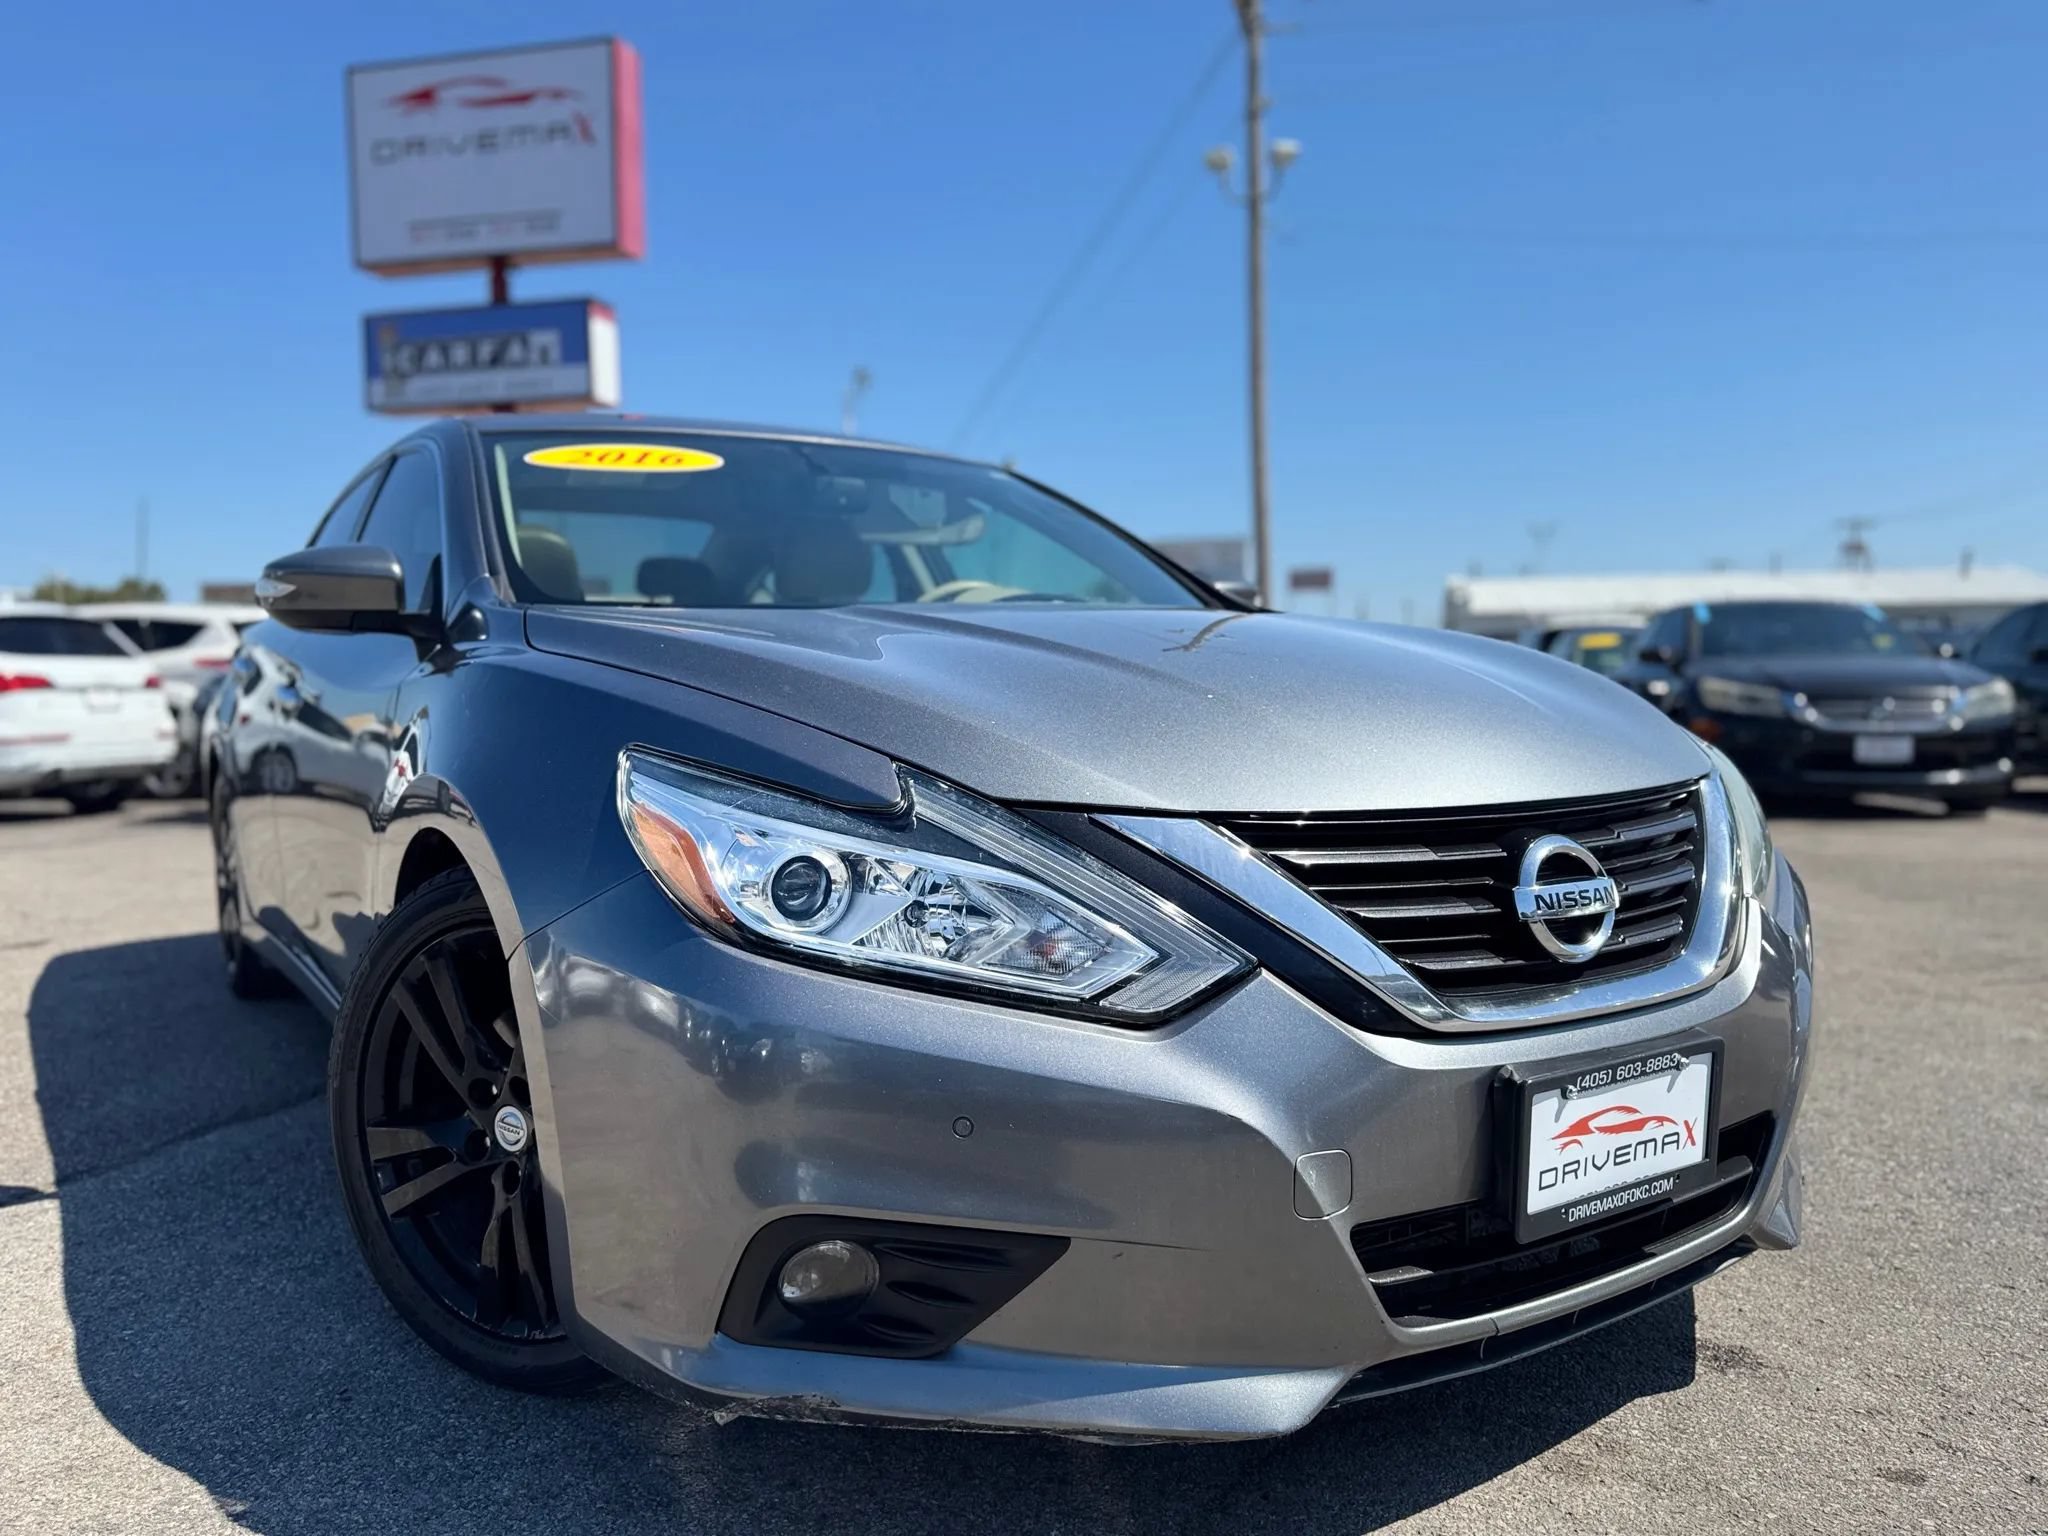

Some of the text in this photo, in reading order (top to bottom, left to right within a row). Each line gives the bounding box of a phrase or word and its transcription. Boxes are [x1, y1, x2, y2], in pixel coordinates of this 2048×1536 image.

[568, 450, 686, 466] 2016
[1534, 886, 1614, 911] NISSAN
[1576, 1053, 1679, 1090] (405) 603-8883
[1538, 1117, 1697, 1191] DRIVEMAX
[1568, 1177, 1674, 1222] DRIVEMAXOFOKC.COM
